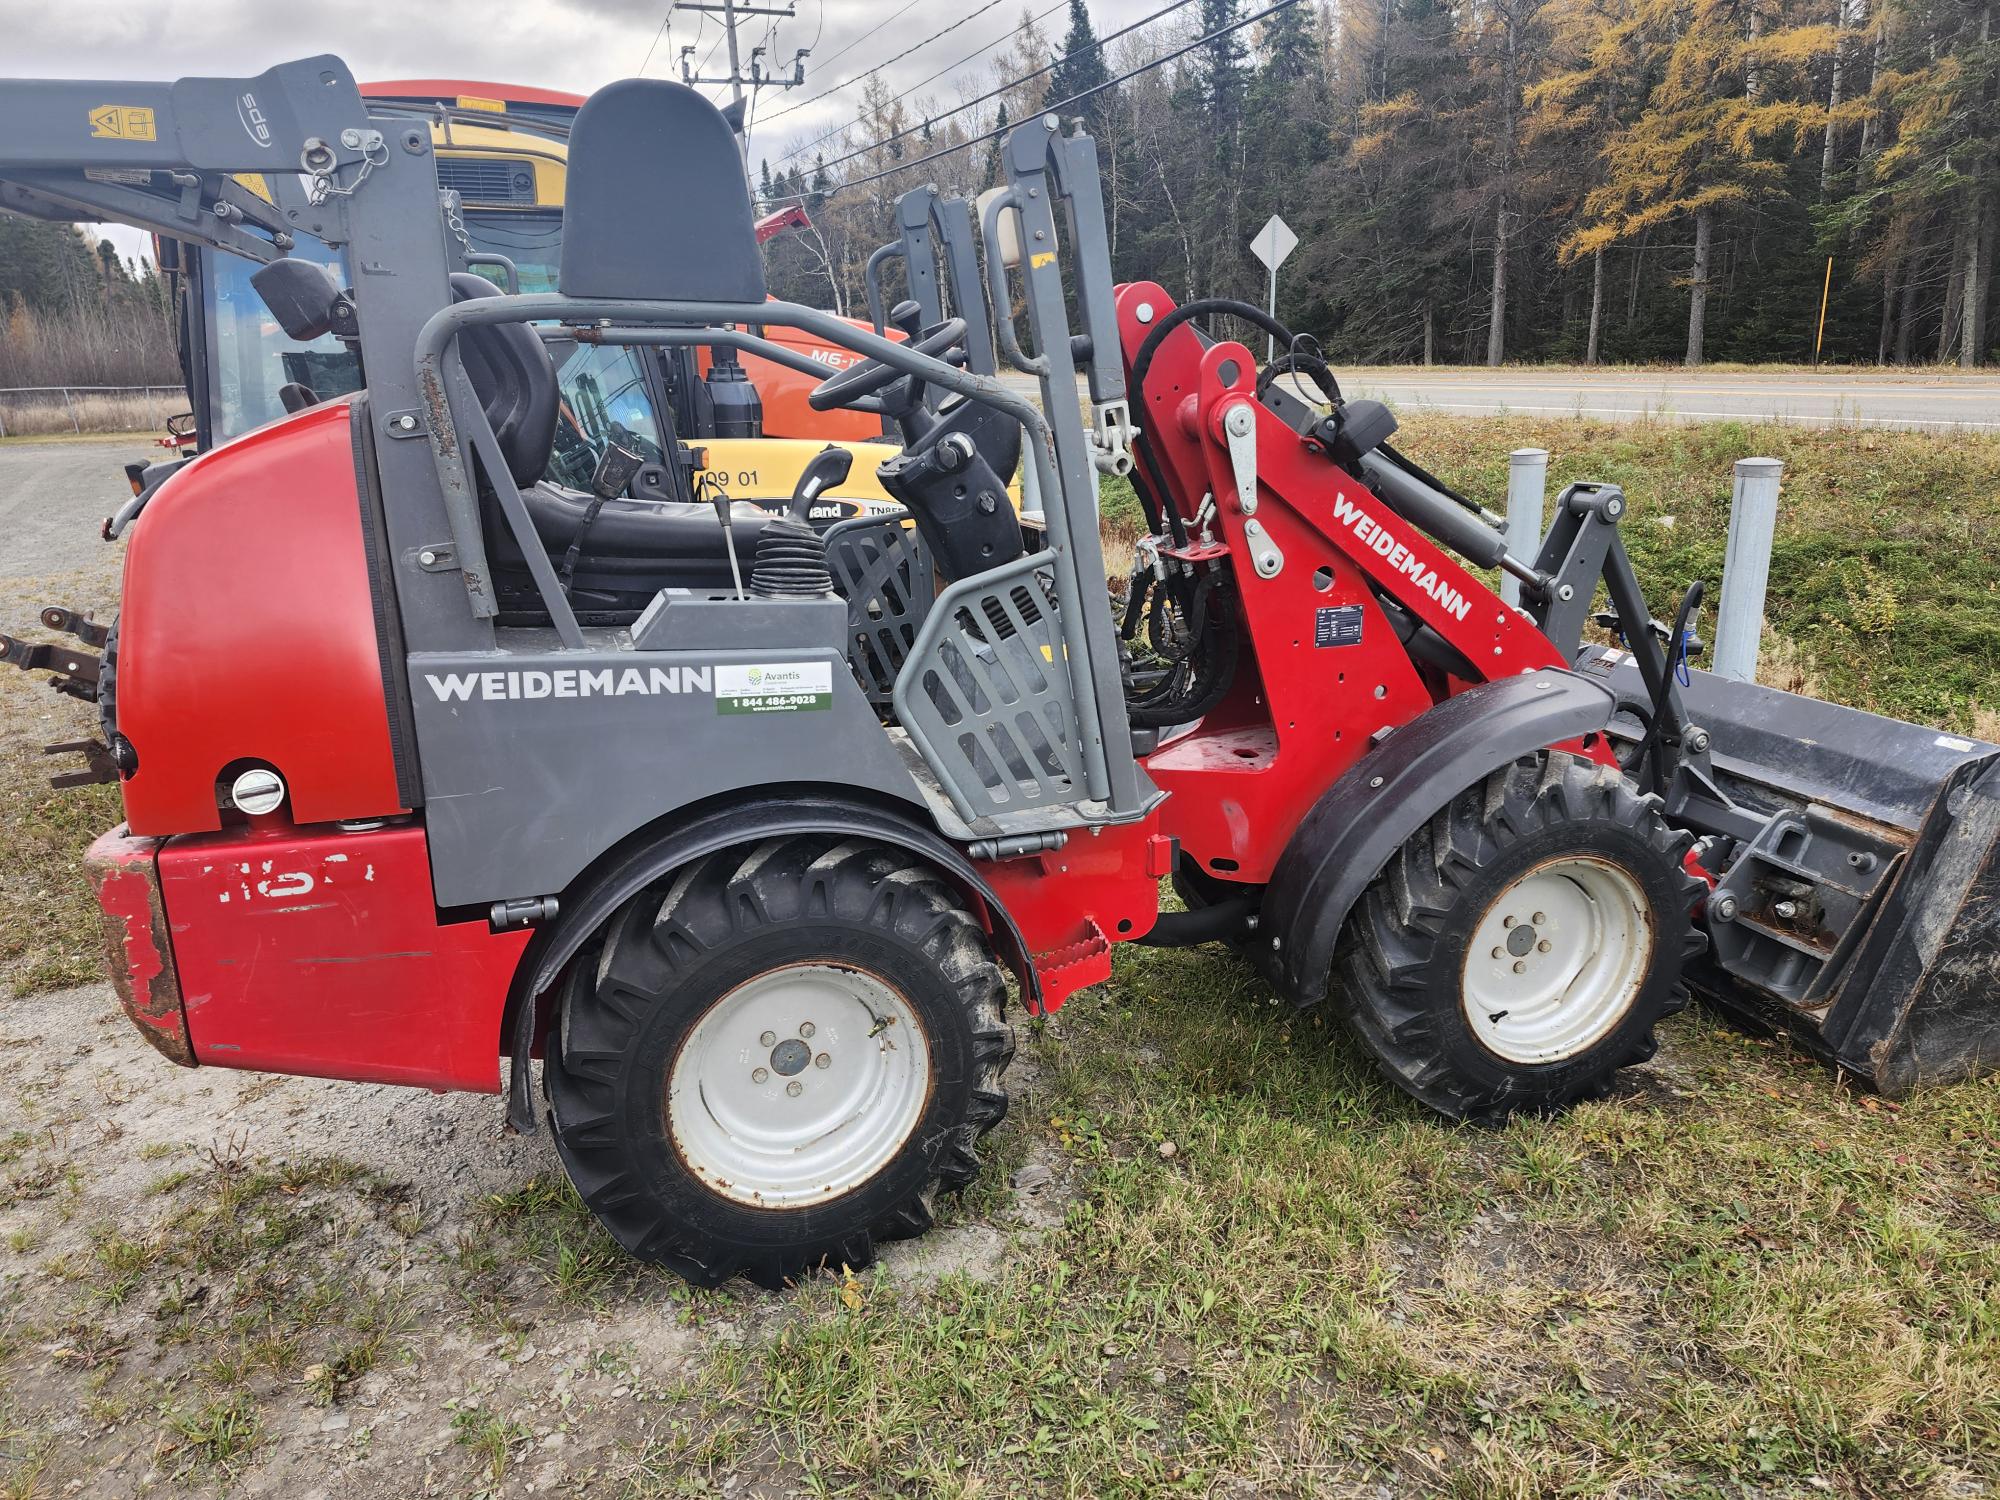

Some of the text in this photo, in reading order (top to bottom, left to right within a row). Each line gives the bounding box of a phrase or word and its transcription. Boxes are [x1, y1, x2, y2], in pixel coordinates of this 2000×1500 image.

[738, 470, 757, 486] 01
[1333, 492, 1472, 621] WEIDEMANN
[424, 667, 712, 702] WEIDEMANN
[764, 672, 800, 681] Avantis
[732, 695, 817, 707] 1 844 486-9028
